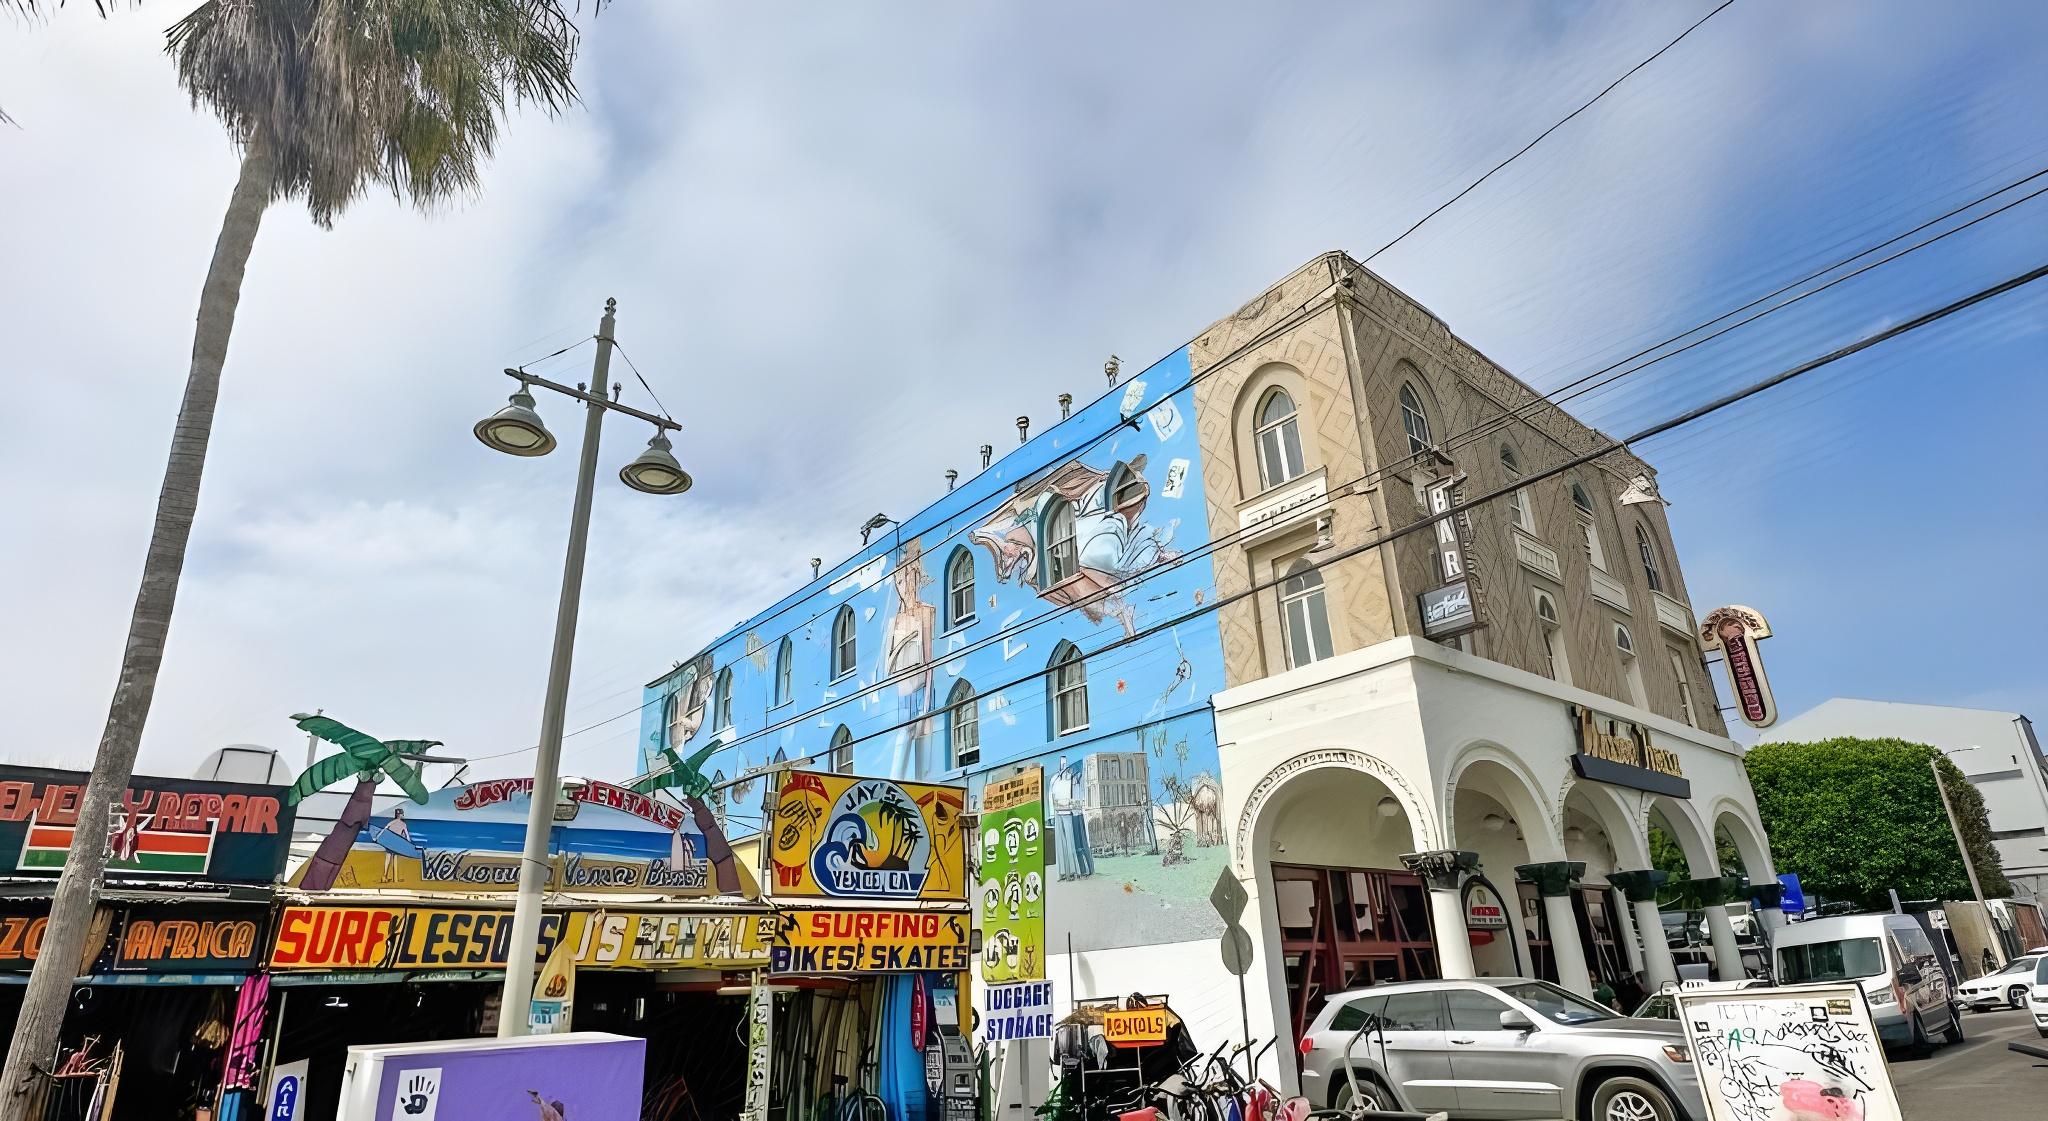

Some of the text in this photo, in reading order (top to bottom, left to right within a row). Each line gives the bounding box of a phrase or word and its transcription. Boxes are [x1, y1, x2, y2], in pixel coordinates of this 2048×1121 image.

[1432, 488, 1462, 578] BAR
[124, 919, 257, 960] AFRICA
[273, 910, 561, 964] SURF LESSOS
[811, 913, 939, 938] SURFING
[870, 945, 968, 969] SKATES
[986, 983, 1051, 1011] LUGGAGE
[987, 1013, 1053, 1041] STORAGE
